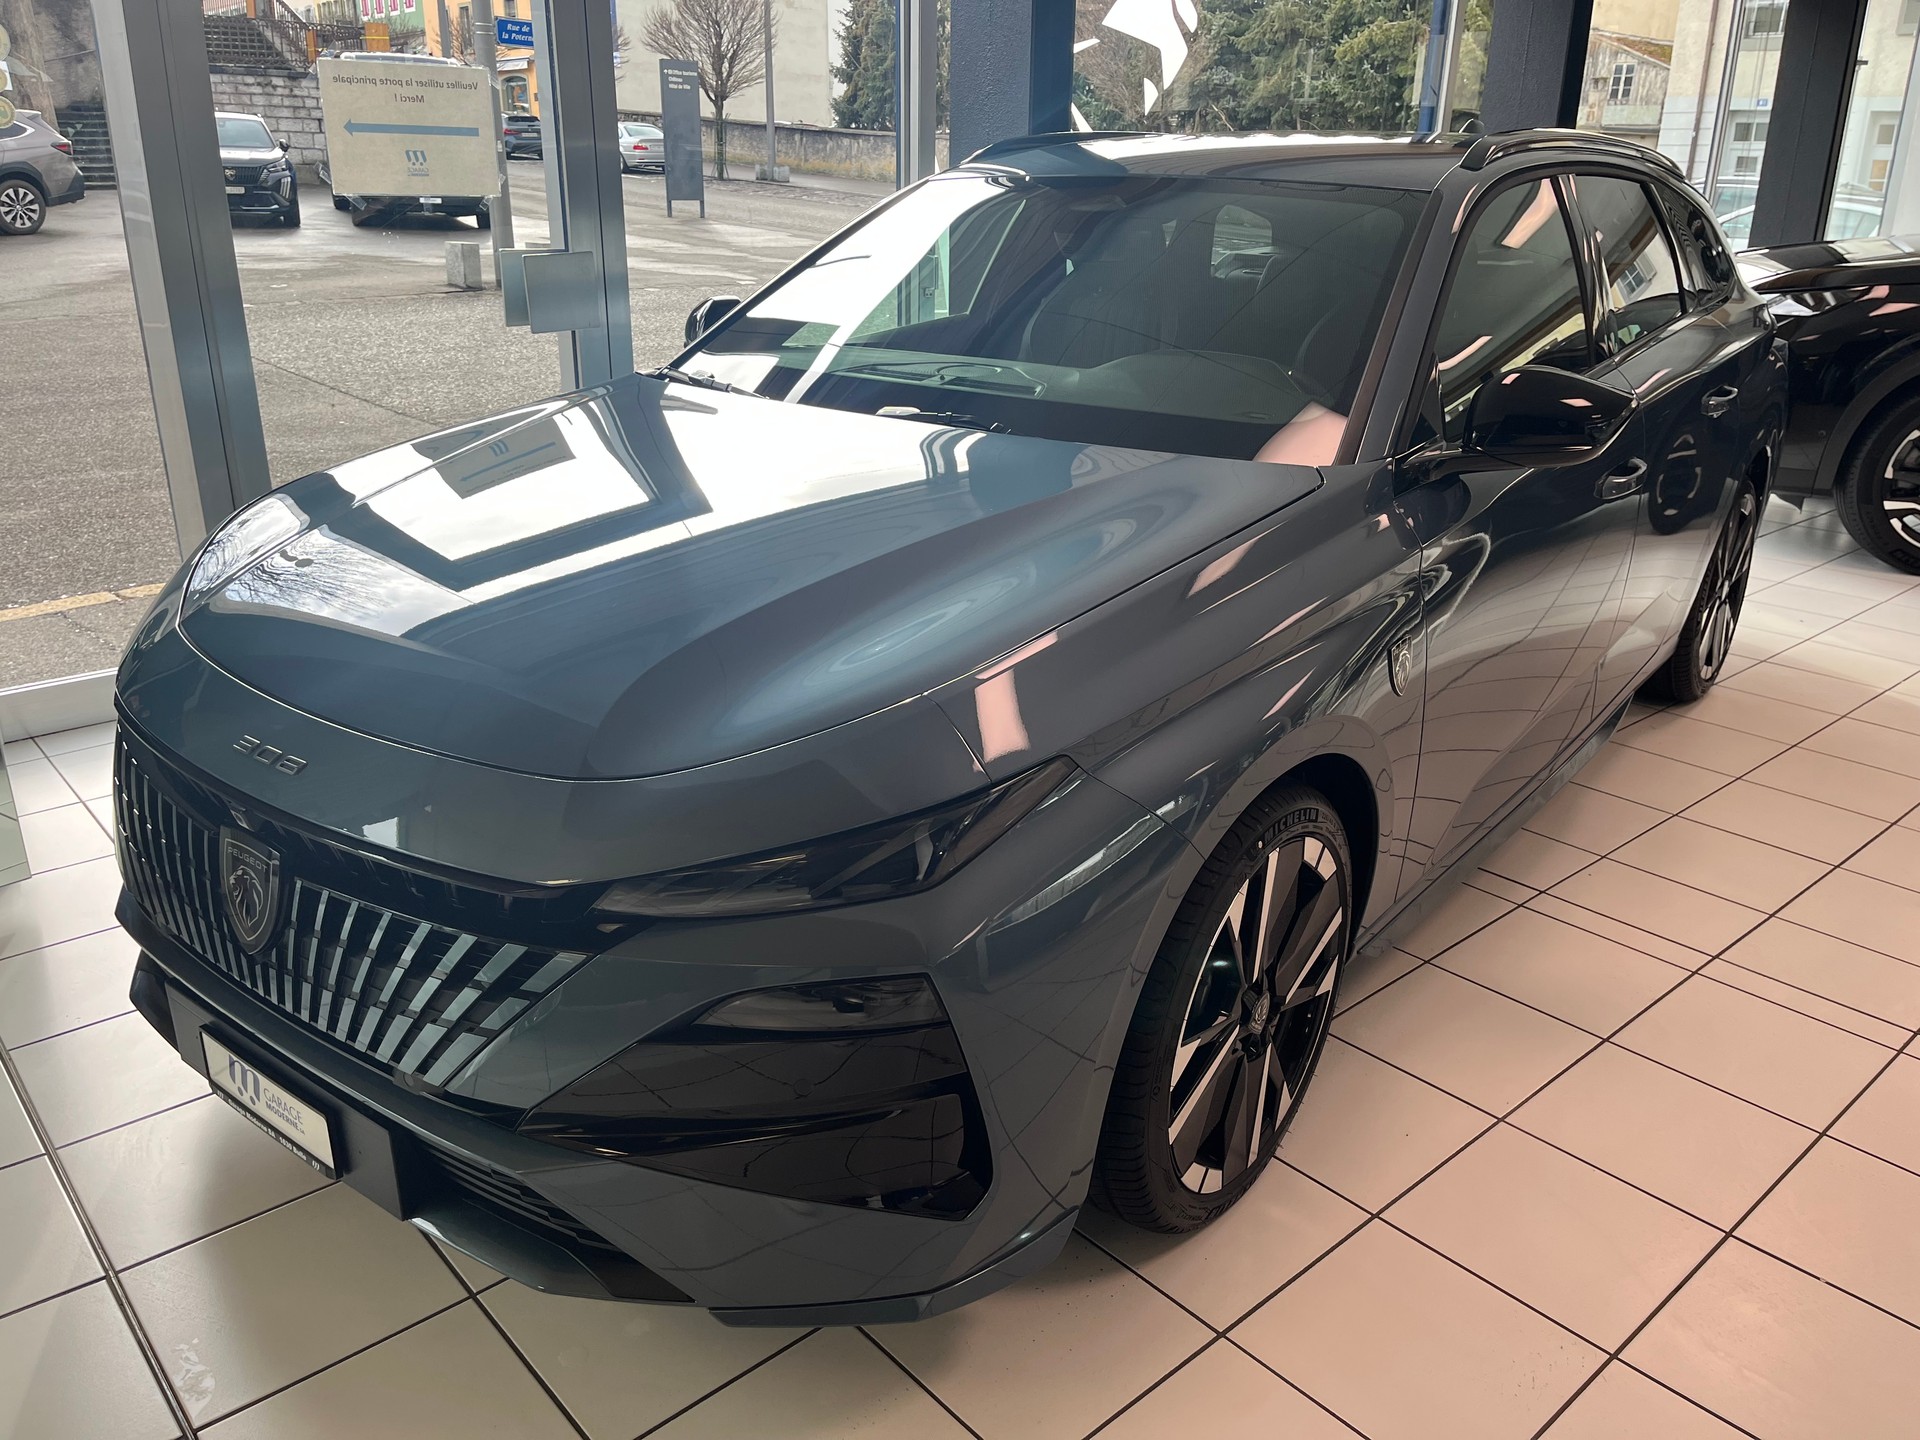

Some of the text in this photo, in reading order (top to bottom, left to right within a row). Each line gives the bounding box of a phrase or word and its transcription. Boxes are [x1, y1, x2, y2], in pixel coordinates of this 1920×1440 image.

[502, 31, 533, 41] la Potern
[507, 23, 530, 32] Rue de
[233, 734, 307, 776] 308
[1264, 808, 1317, 843] MICHELIN
[227, 846, 268, 874] PEUGEOT
[263, 1087, 304, 1125] GARAGE
[265, 1101, 300, 1131] MODERNE
